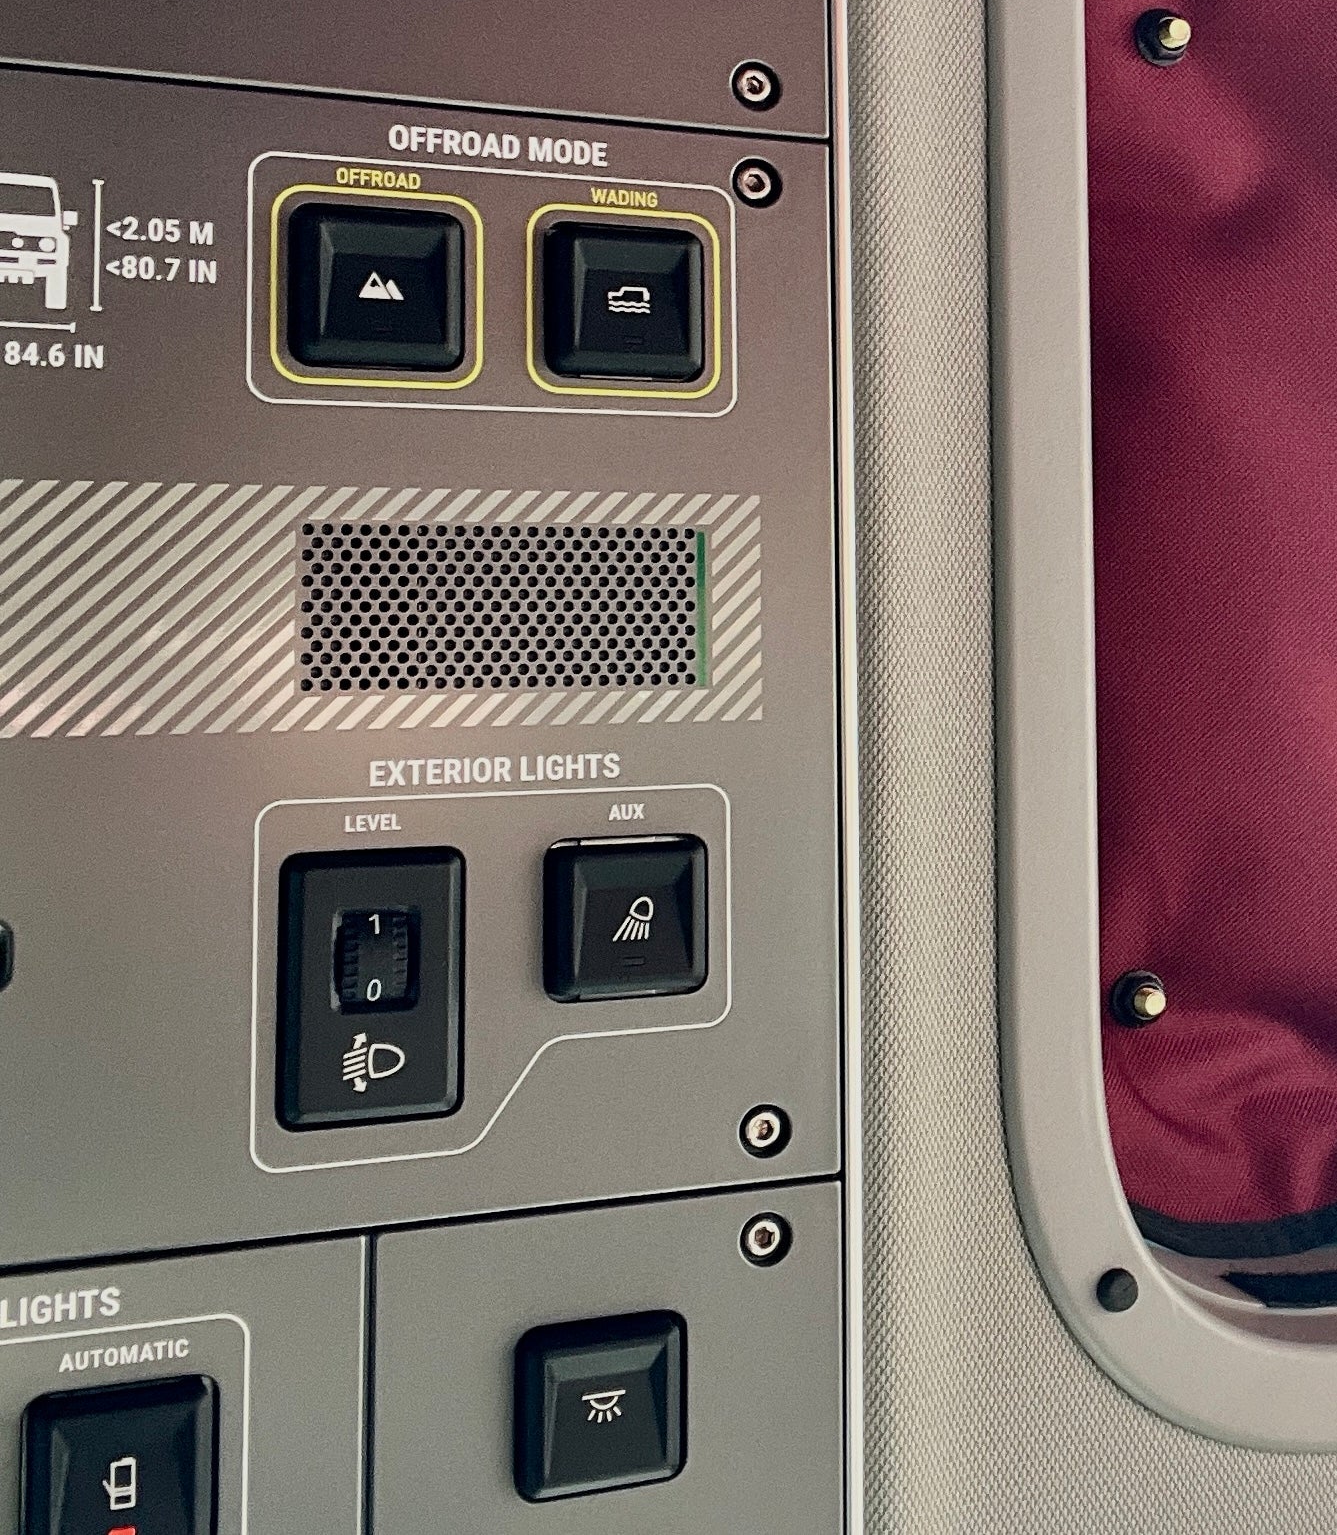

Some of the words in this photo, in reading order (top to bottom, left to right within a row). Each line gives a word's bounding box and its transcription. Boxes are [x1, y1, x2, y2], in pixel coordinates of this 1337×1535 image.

[388, 123, 520, 160] OFFROAD
[528, 136, 608, 167] MODE
[335, 167, 421, 190] OFFROAD
[591, 187, 658, 209] WADING
[188, 220, 214, 246] M
[188, 259, 217, 284] IN
[4, 340, 66, 368] 84.6
[74, 343, 104, 370] IN
[369, 756, 512, 787] EXTERIOR
[519, 752, 620, 781] LIGHTS
[344, 813, 402, 834] LEVEL
[608, 803, 645, 822] AUX
[368, 913, 381, 935] 1
[366, 978, 382, 1002] 0
[0, 1286, 121, 1329] LIGHTS
[58, 1338, 190, 1373] AUTOMATIC
